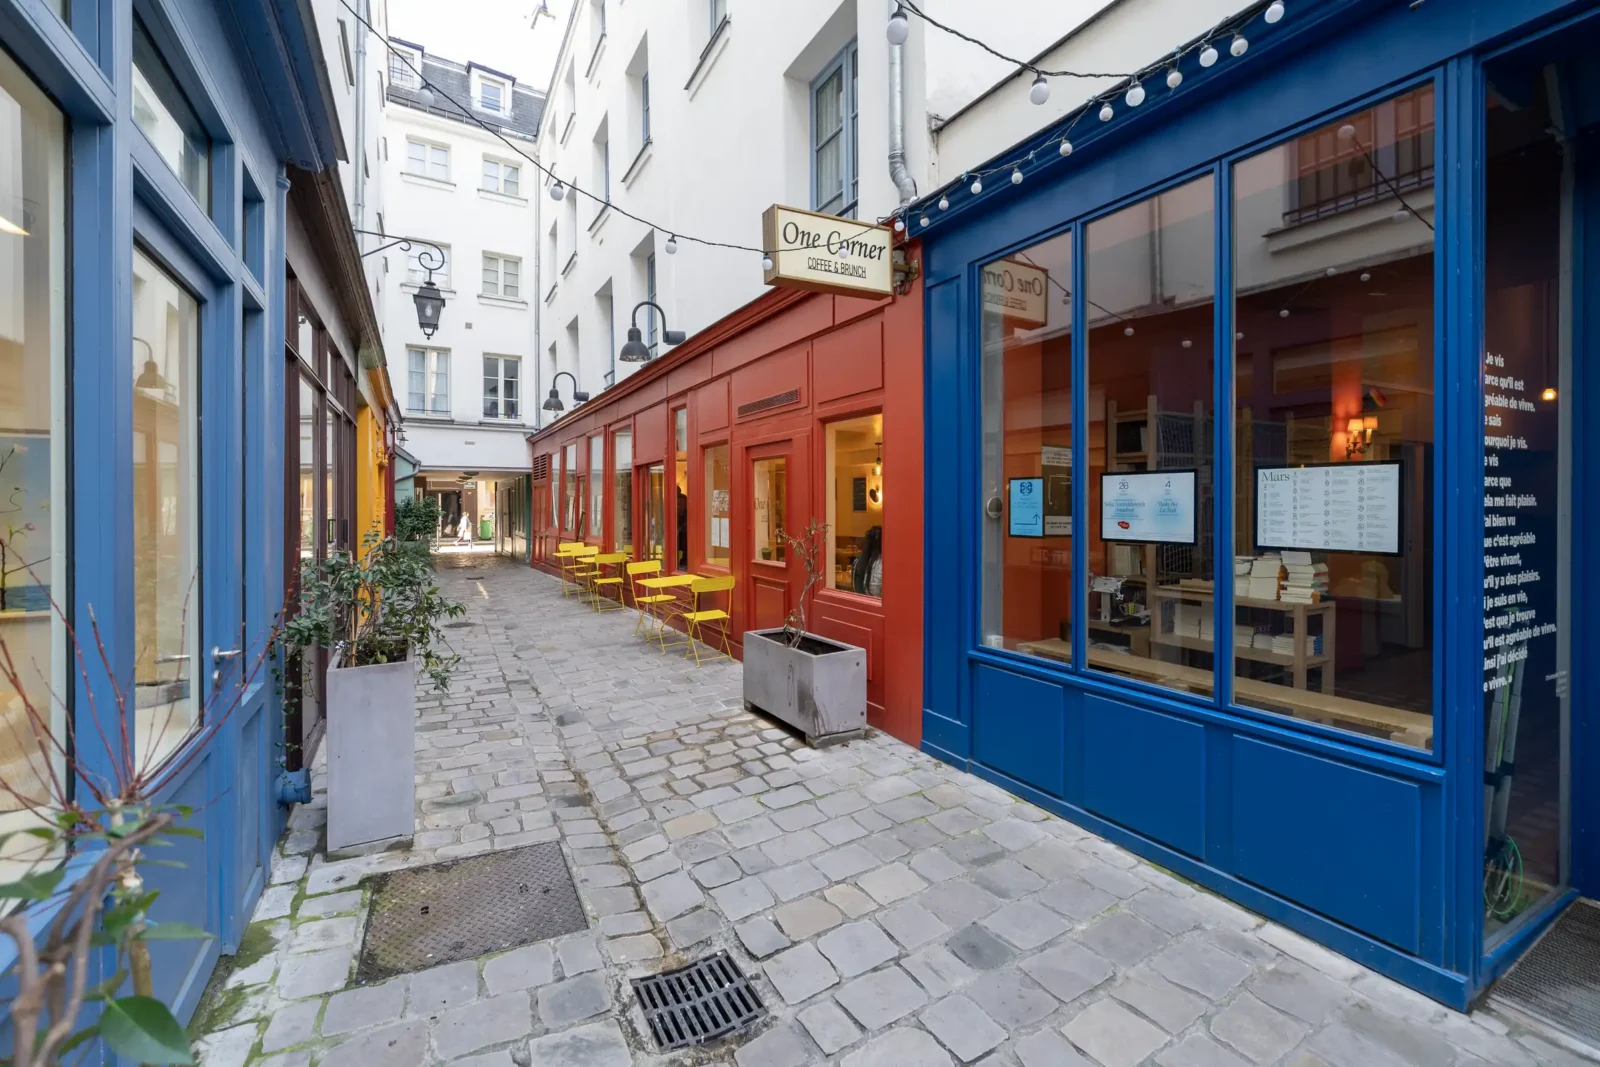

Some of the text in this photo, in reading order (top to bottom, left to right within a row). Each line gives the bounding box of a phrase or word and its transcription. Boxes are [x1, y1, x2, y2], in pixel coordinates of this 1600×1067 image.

[783, 222, 886, 260] One Corner
[808, 257, 866, 278] COFFEE & BRUNCH
[1486, 352, 1504, 367] Je vis
[1485, 374, 1524, 391] arce qu'il est
[1485, 393, 1535, 412] gréable de vivre.
[1489, 414, 1501, 426] sais
[1484, 435, 1509, 449] ourquoi
[1510, 436, 1516, 450] je
[1489, 454, 1498, 466] vis
[1262, 472, 1290, 481] Mars
[1484, 477, 1511, 489] arce que
[1484, 494, 1493, 507] ela
[1494, 497, 1504, 507] me
[1506, 494, 1517, 507] fait
[1492, 514, 1506, 527] bien
[1508, 516, 1516, 526] vu
[1484, 532, 1536, 547] ue c'est agréable
[1484, 555, 1499, 568] 'être
[1484, 575, 1494, 588] u'il
[1495, 577, 1499, 589] y
[1500, 576, 1505, 586] a
[1506, 573, 1516, 585] des
[1487, 596, 1493, 611] je
[1494, 593, 1507, 607] suis
[1508, 592, 1516, 604] en
[1496, 615, 1508, 628] que
[1509, 612, 1515, 626] je
[1516, 610, 1536, 622] trouve
[1484, 636, 1494, 650] u'il
[1495, 634, 1505, 647] est
[1506, 627, 1532, 645] agréable
[1533, 625, 1540, 637] de
[1484, 646, 1528, 670] insi j'ai décidé
[1483, 681, 1488, 692] e
